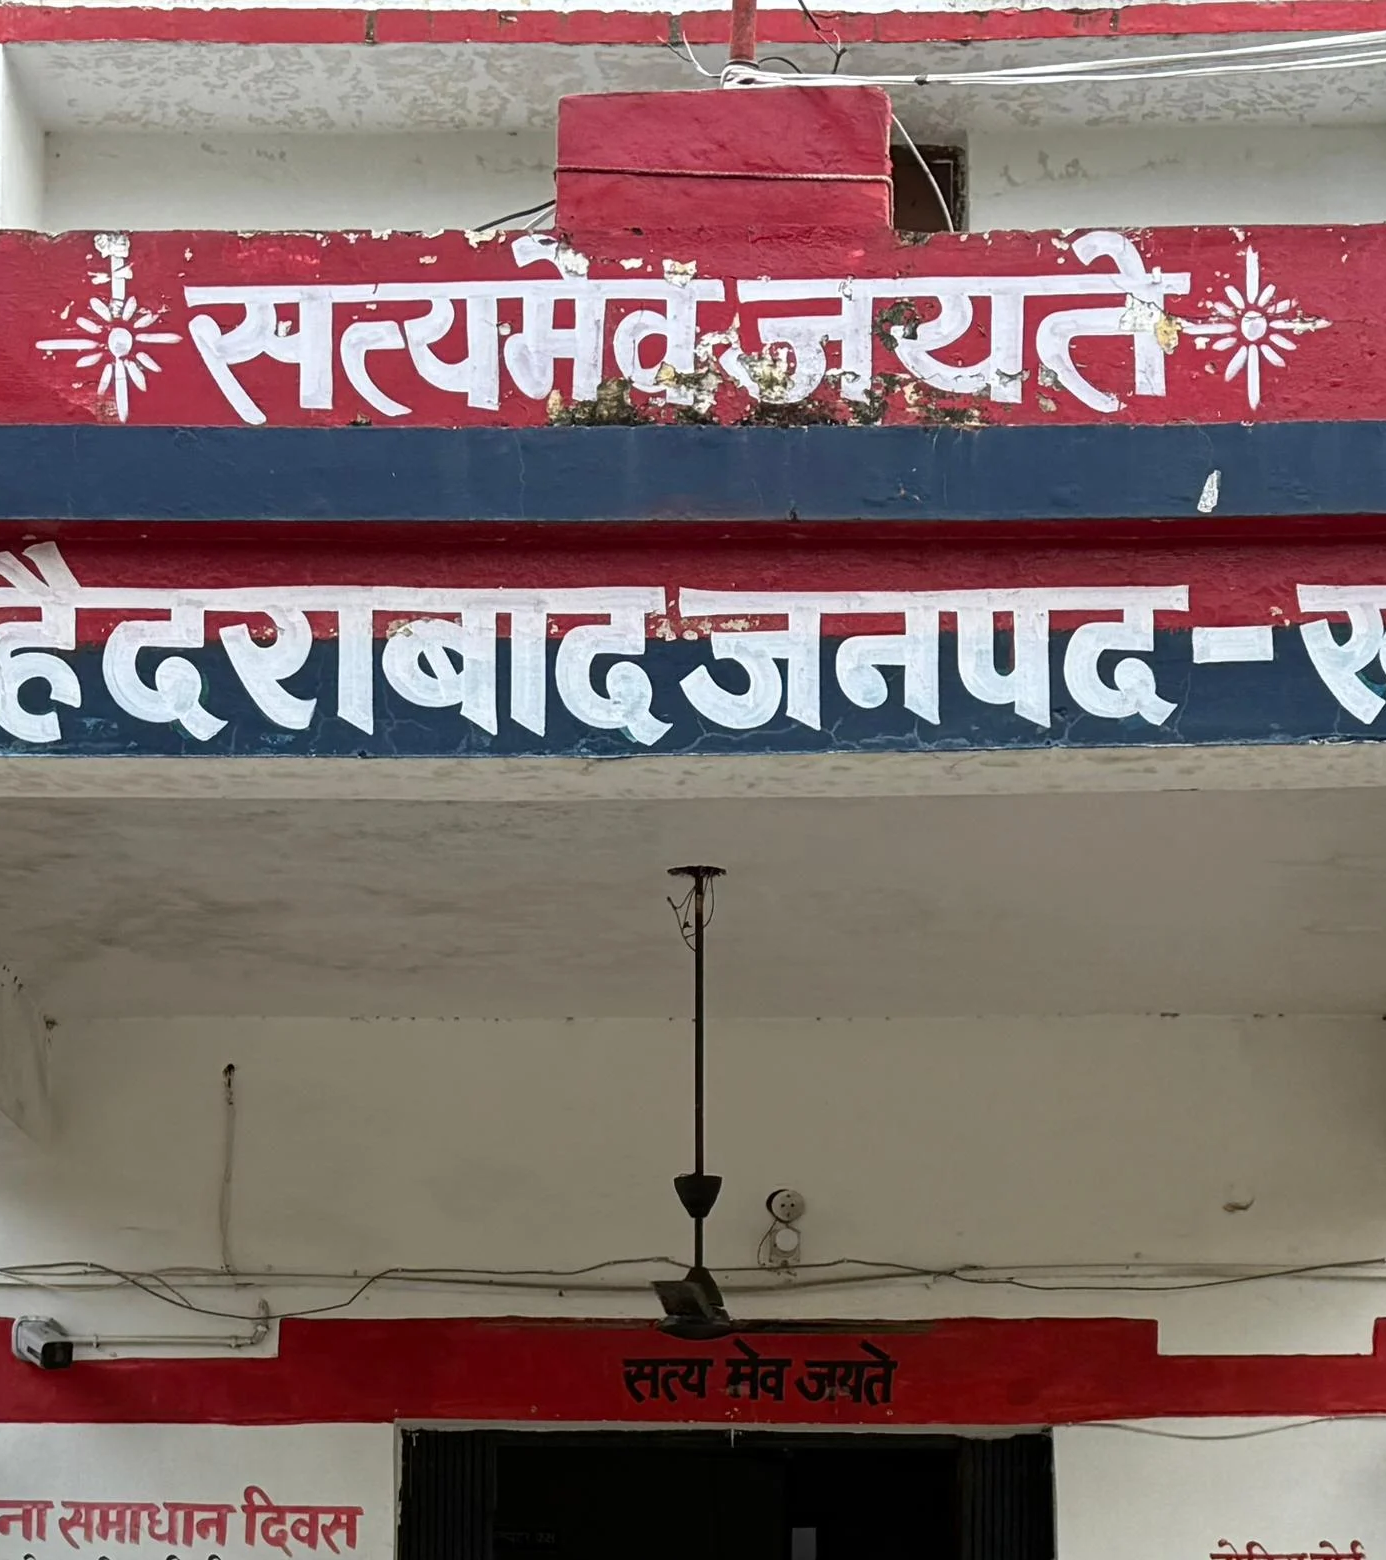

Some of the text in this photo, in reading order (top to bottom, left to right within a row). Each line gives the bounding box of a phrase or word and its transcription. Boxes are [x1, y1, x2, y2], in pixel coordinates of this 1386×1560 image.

[184, 232, 1191, 424] सत्यमेव जयते
[679, 586, 1189, 731] जनपद
[622, 1338, 898, 1406] सत्य मेव जयते
[58, 1499, 238, 1550] समाधान
[241, 1485, 364, 1558] दिवस
